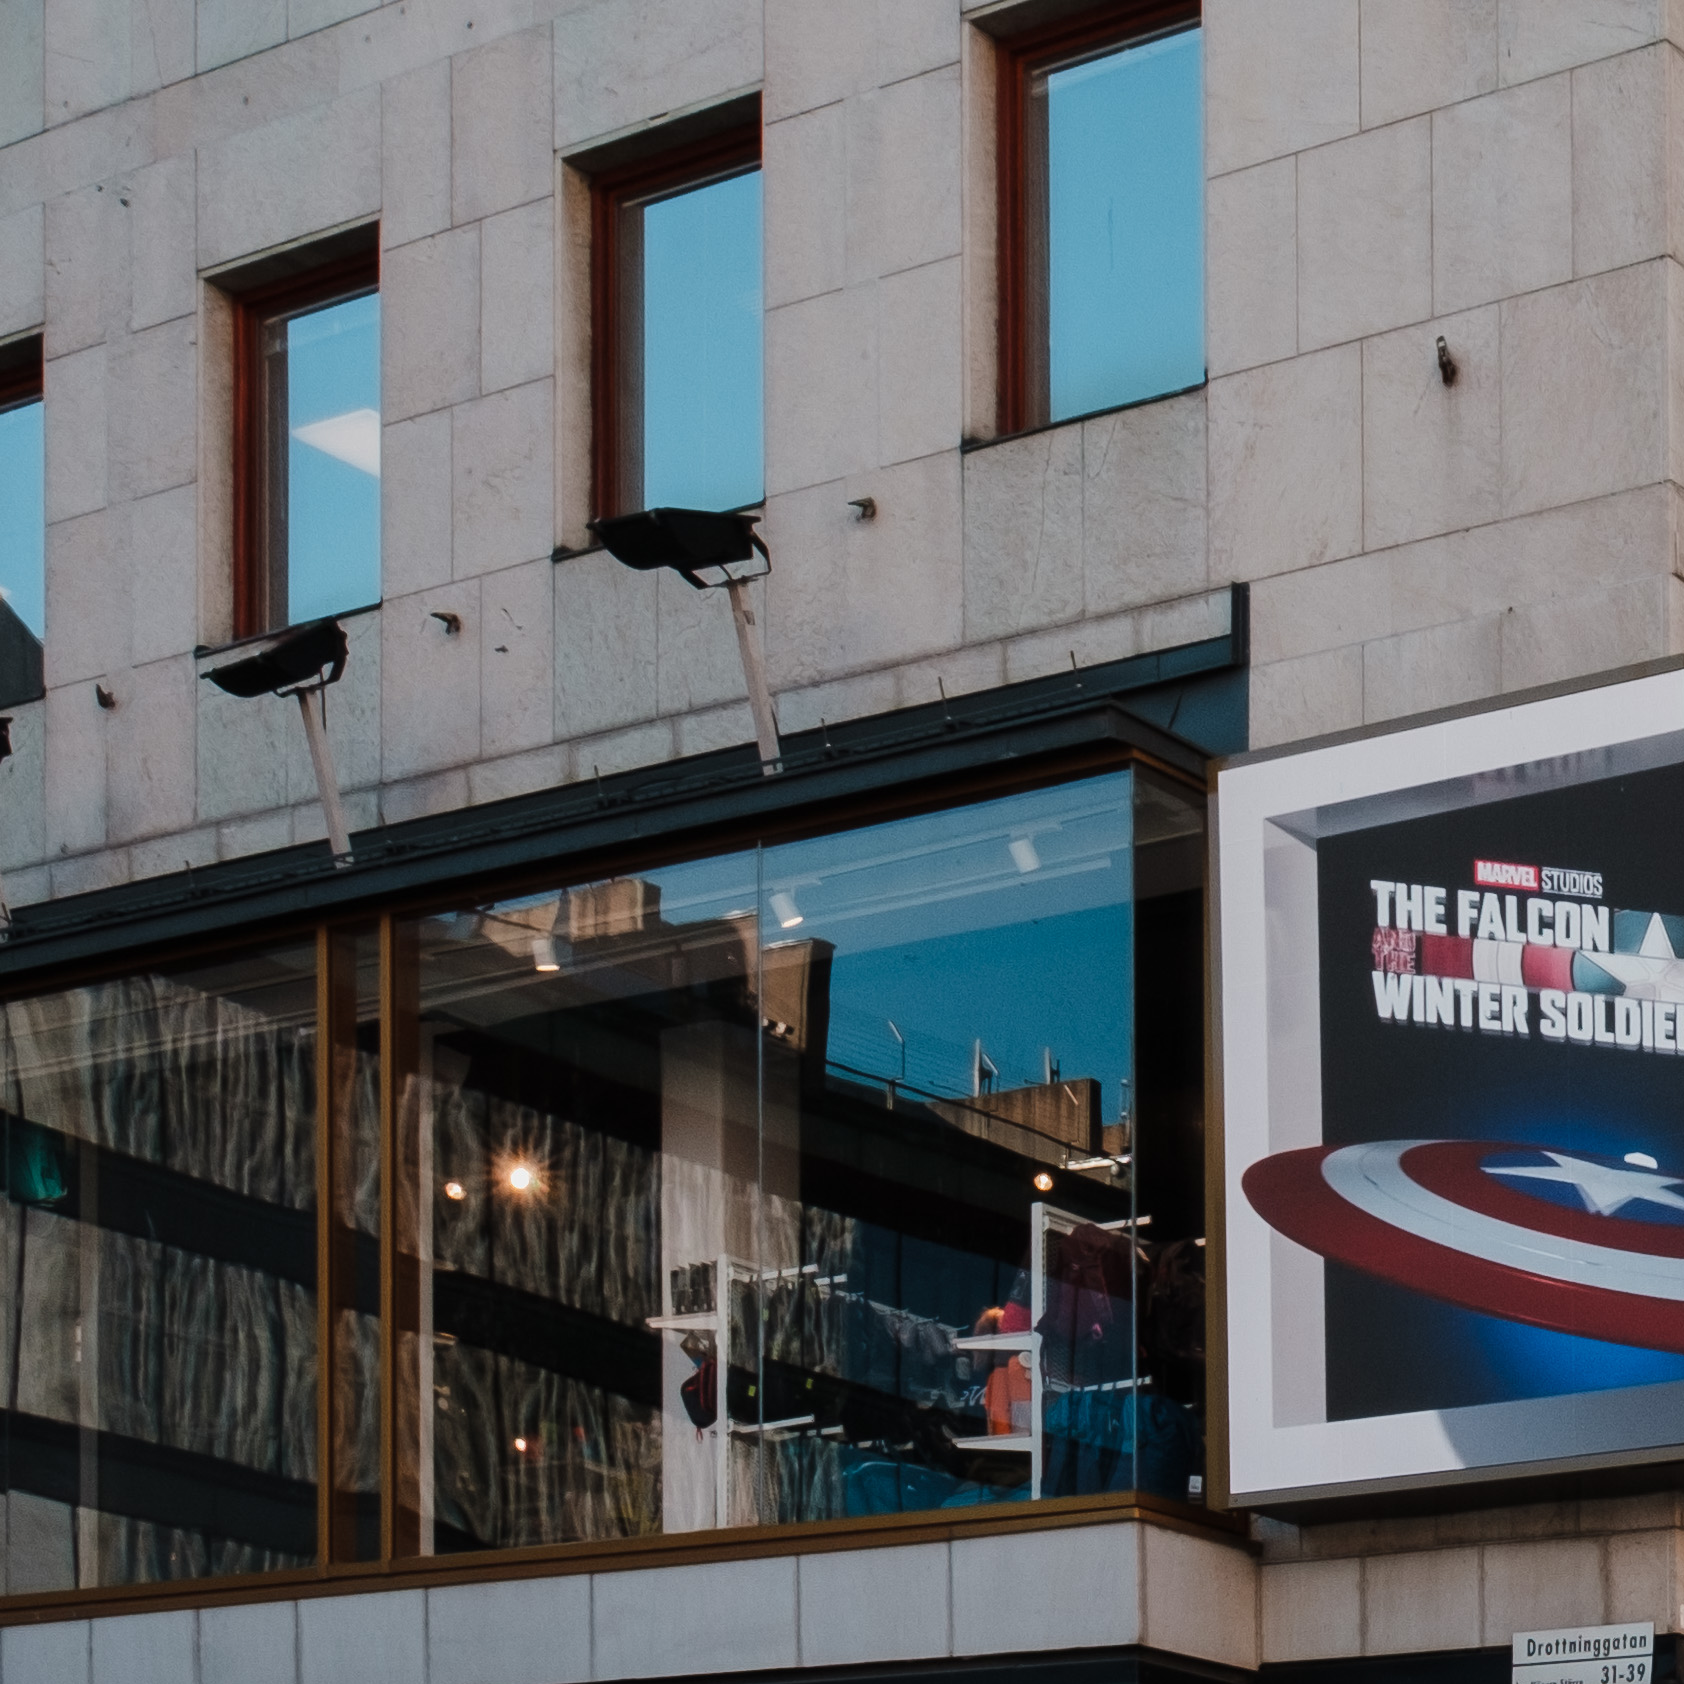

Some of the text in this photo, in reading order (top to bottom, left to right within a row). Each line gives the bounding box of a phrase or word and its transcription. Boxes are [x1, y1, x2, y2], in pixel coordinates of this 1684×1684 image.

[1475, 861, 1603, 897] MARVEL STUDIOS
[1370, 880, 1610, 953] THE FALCON
[1371, 970, 1530, 1036] WINTER
[1527, 1633, 1647, 1657] Drottninggatan
[1601, 1663, 1646, 1684] 31-39
